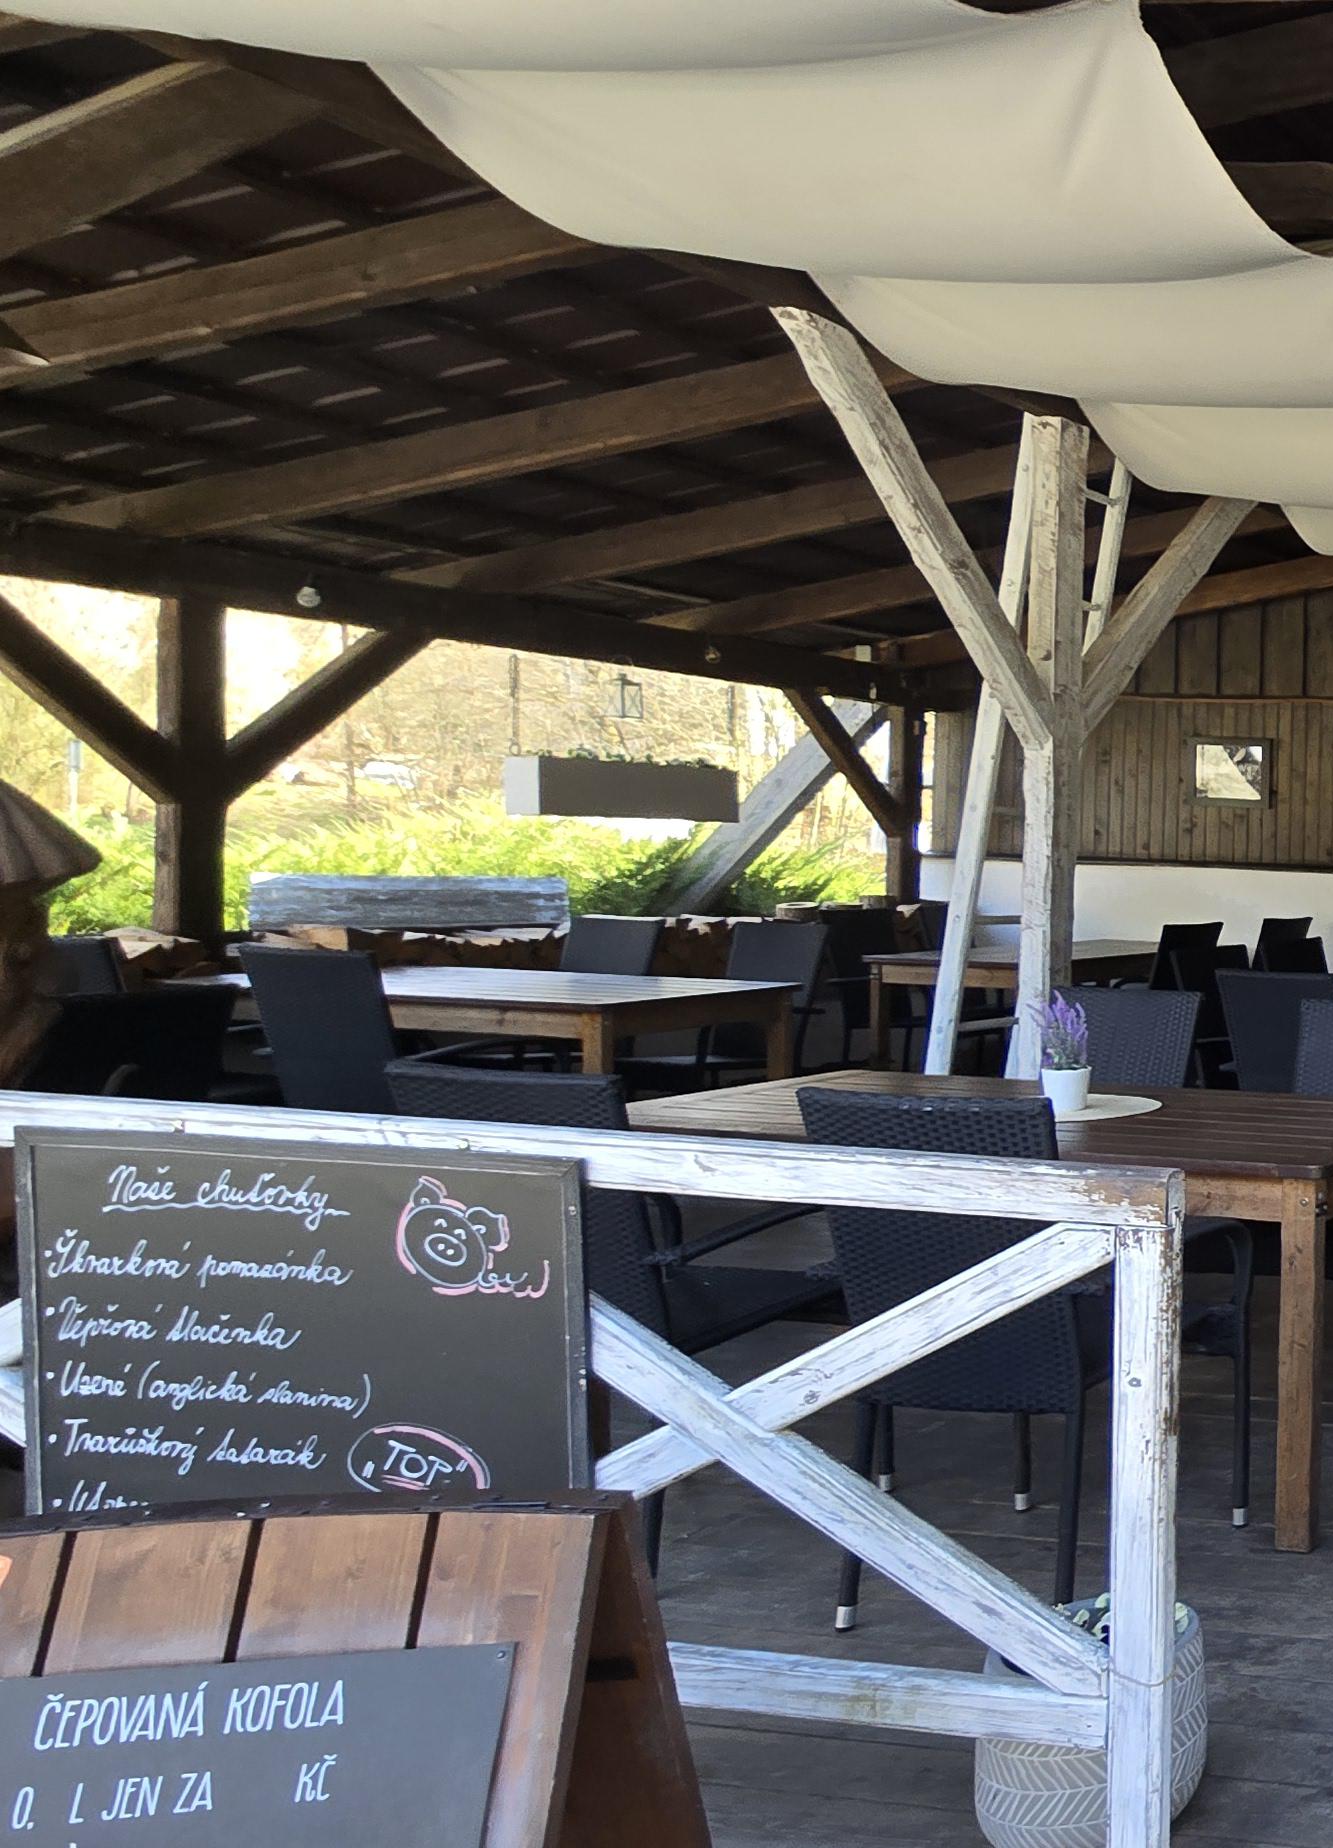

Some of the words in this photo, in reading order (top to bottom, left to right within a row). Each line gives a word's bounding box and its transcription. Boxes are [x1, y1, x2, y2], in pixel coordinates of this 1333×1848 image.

[108, 1164, 177, 1203] Naše
[33, 1680, 210, 1750] ČEPOVANÁ
[223, 1679, 345, 1734] KOFOLA
[68, 1782, 85, 1824] L
[100, 1776, 164, 1821] JEN
[172, 1771, 213, 1814] ZA
[293, 1754, 339, 1802] KČ
